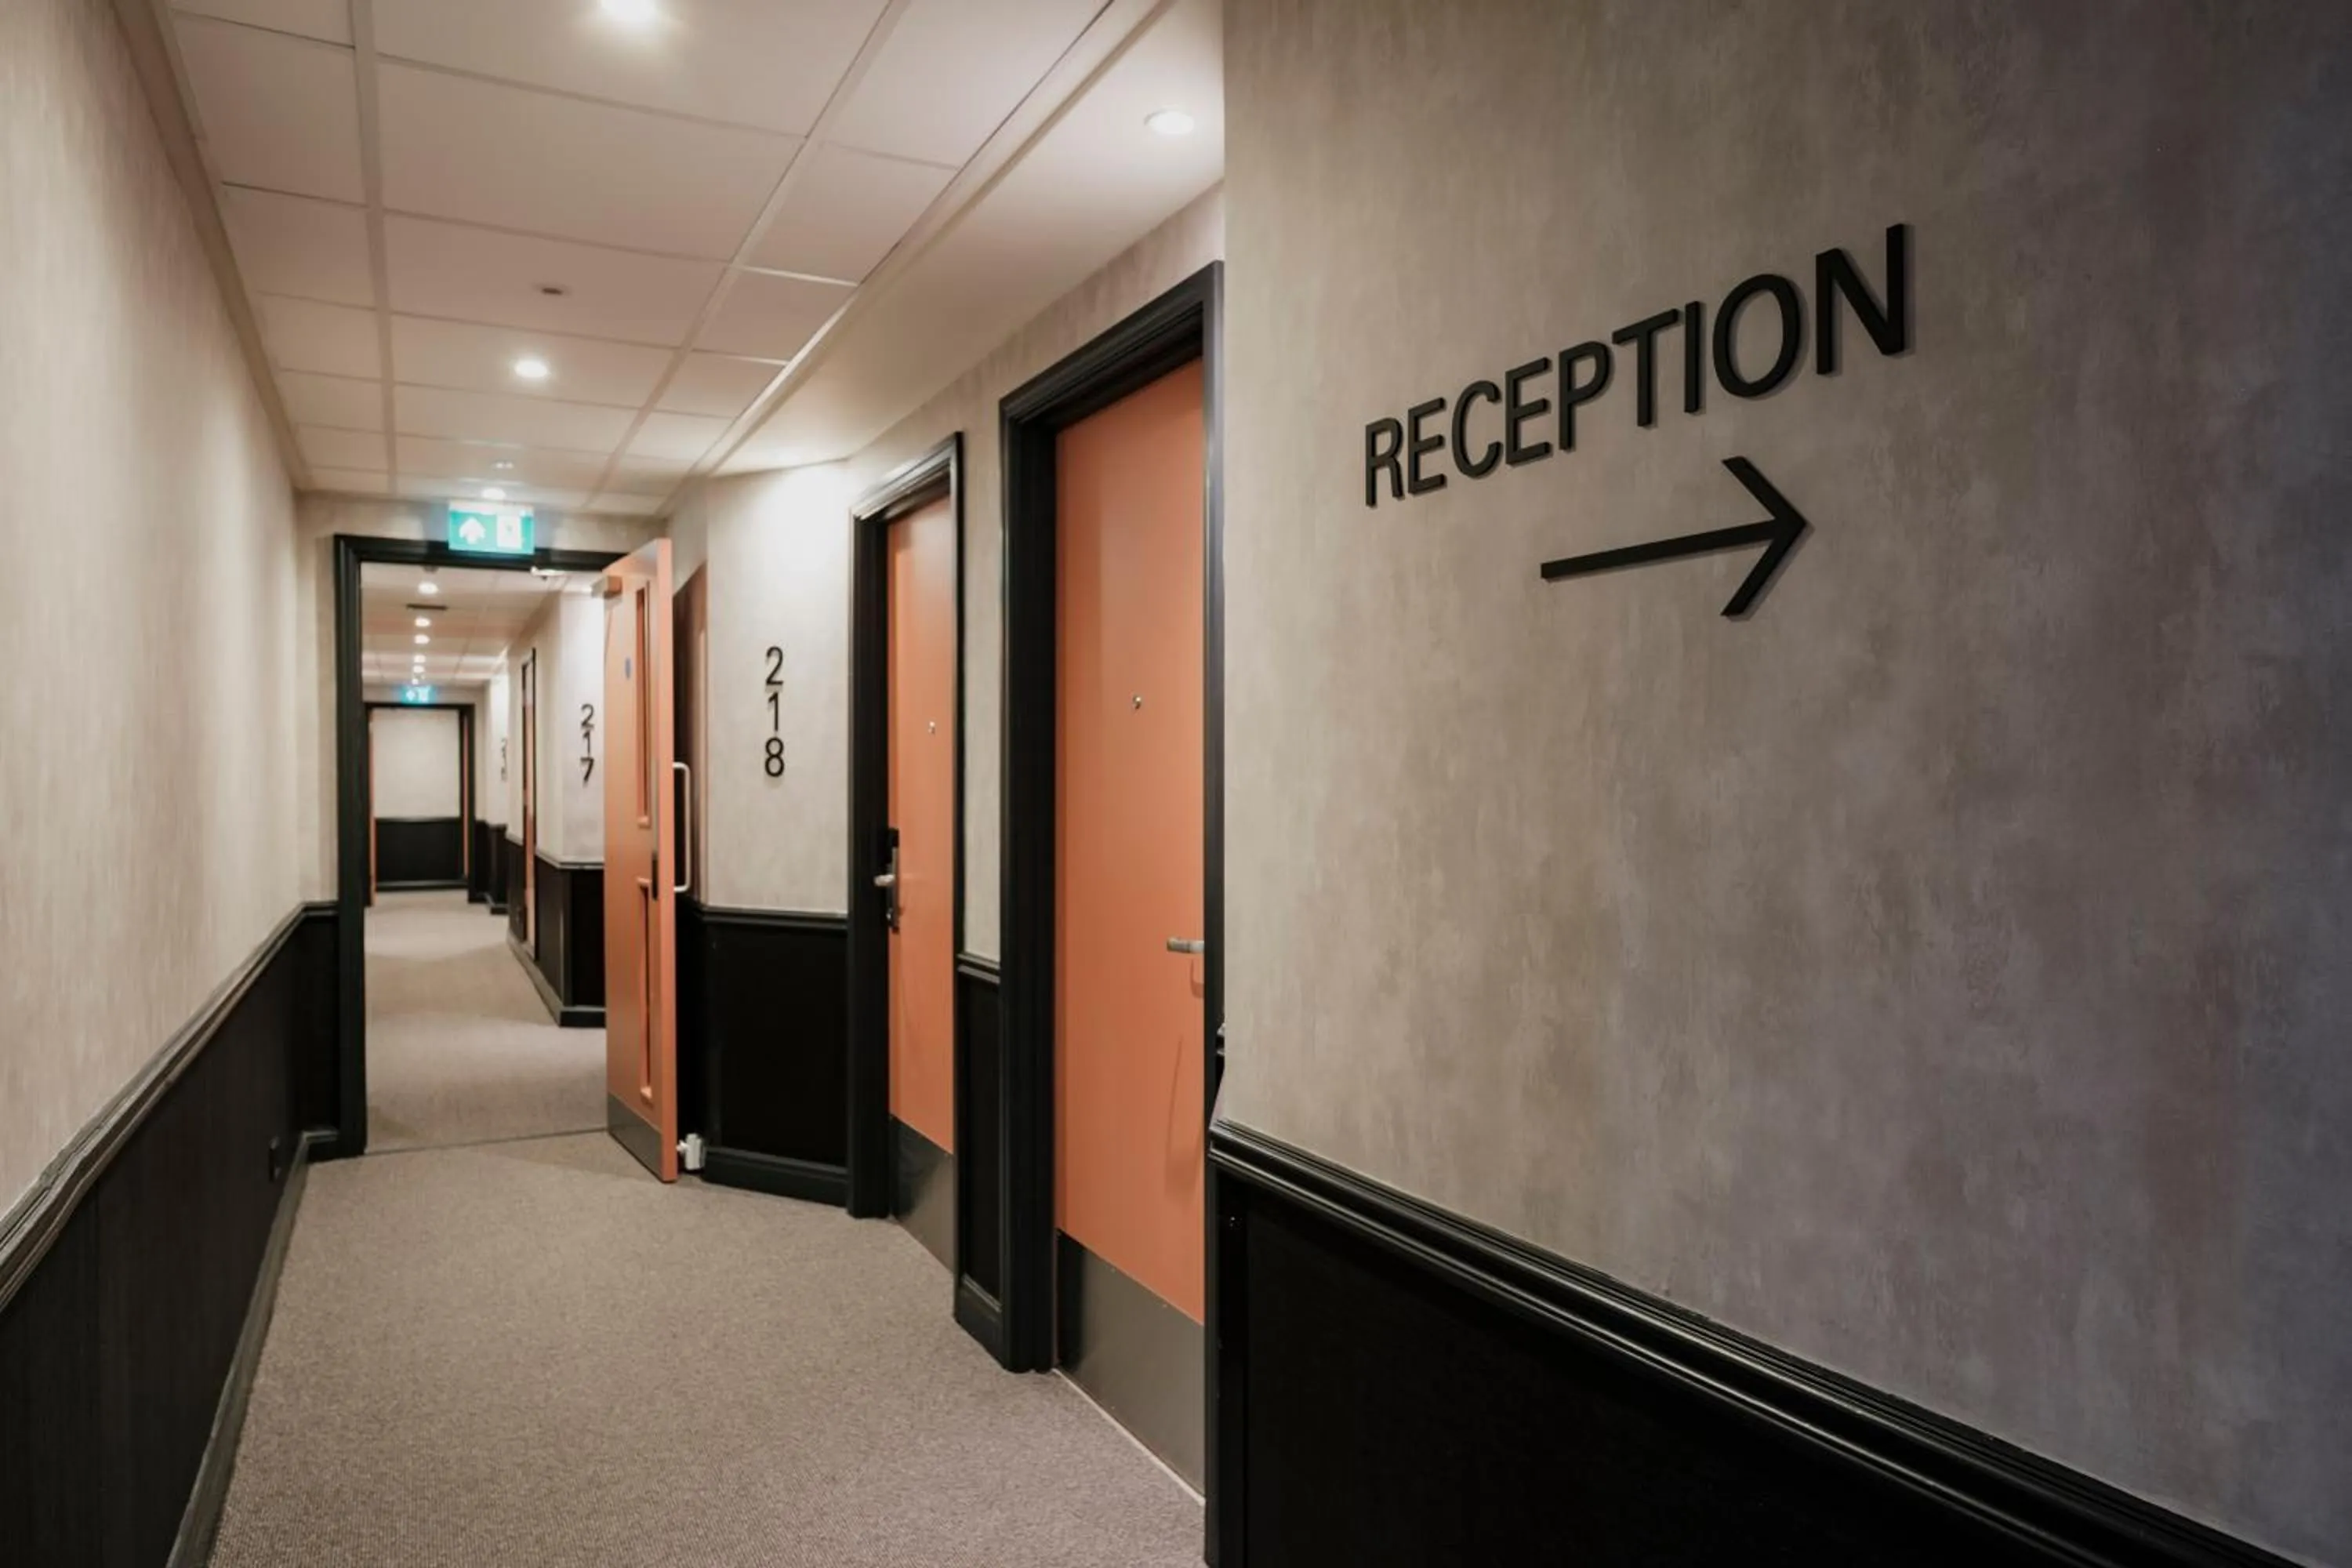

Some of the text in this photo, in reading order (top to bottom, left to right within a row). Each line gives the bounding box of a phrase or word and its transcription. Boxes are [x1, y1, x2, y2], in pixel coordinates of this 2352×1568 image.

[1365, 223, 1907, 507] RECEPTION
[580, 703, 594, 782] 217
[764, 645, 785, 778] 218
